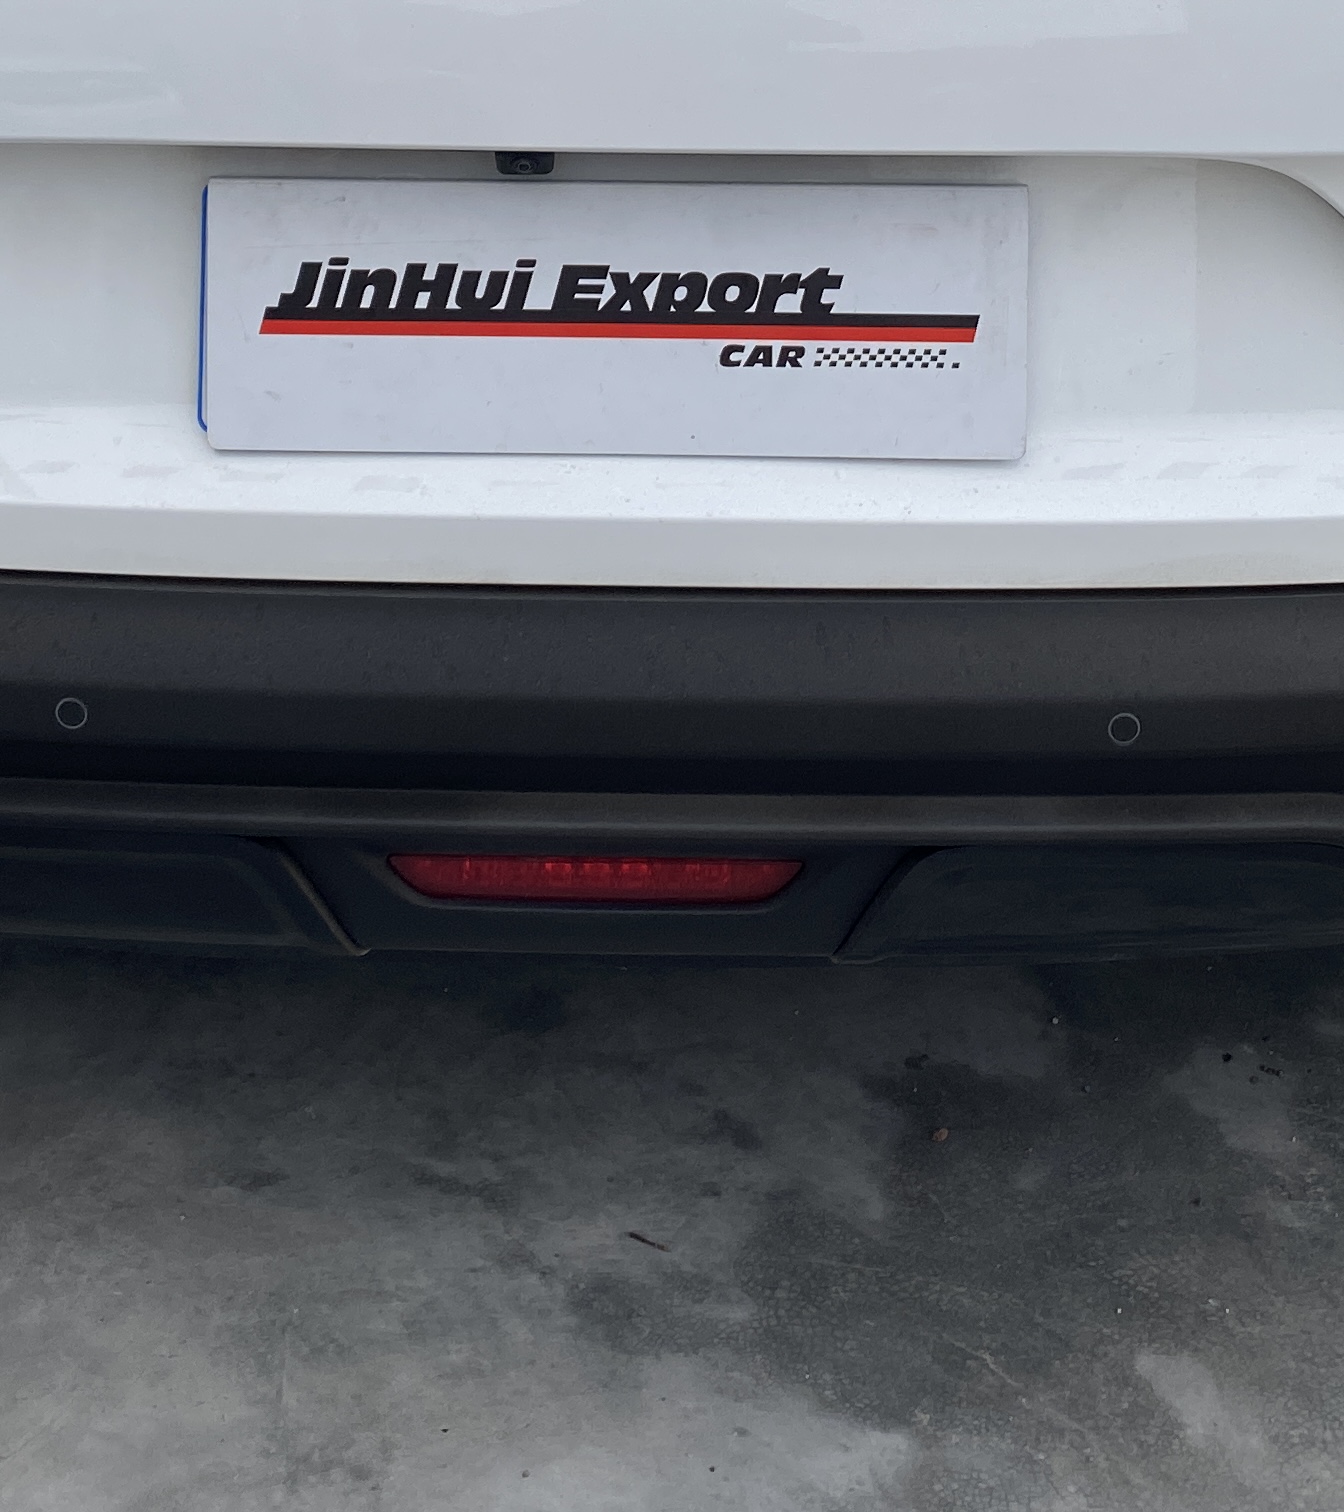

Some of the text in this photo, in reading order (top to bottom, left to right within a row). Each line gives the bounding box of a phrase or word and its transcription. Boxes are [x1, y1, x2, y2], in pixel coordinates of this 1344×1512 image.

[278, 256, 844, 316] JinHui Export
[718, 344, 808, 369] CAR
